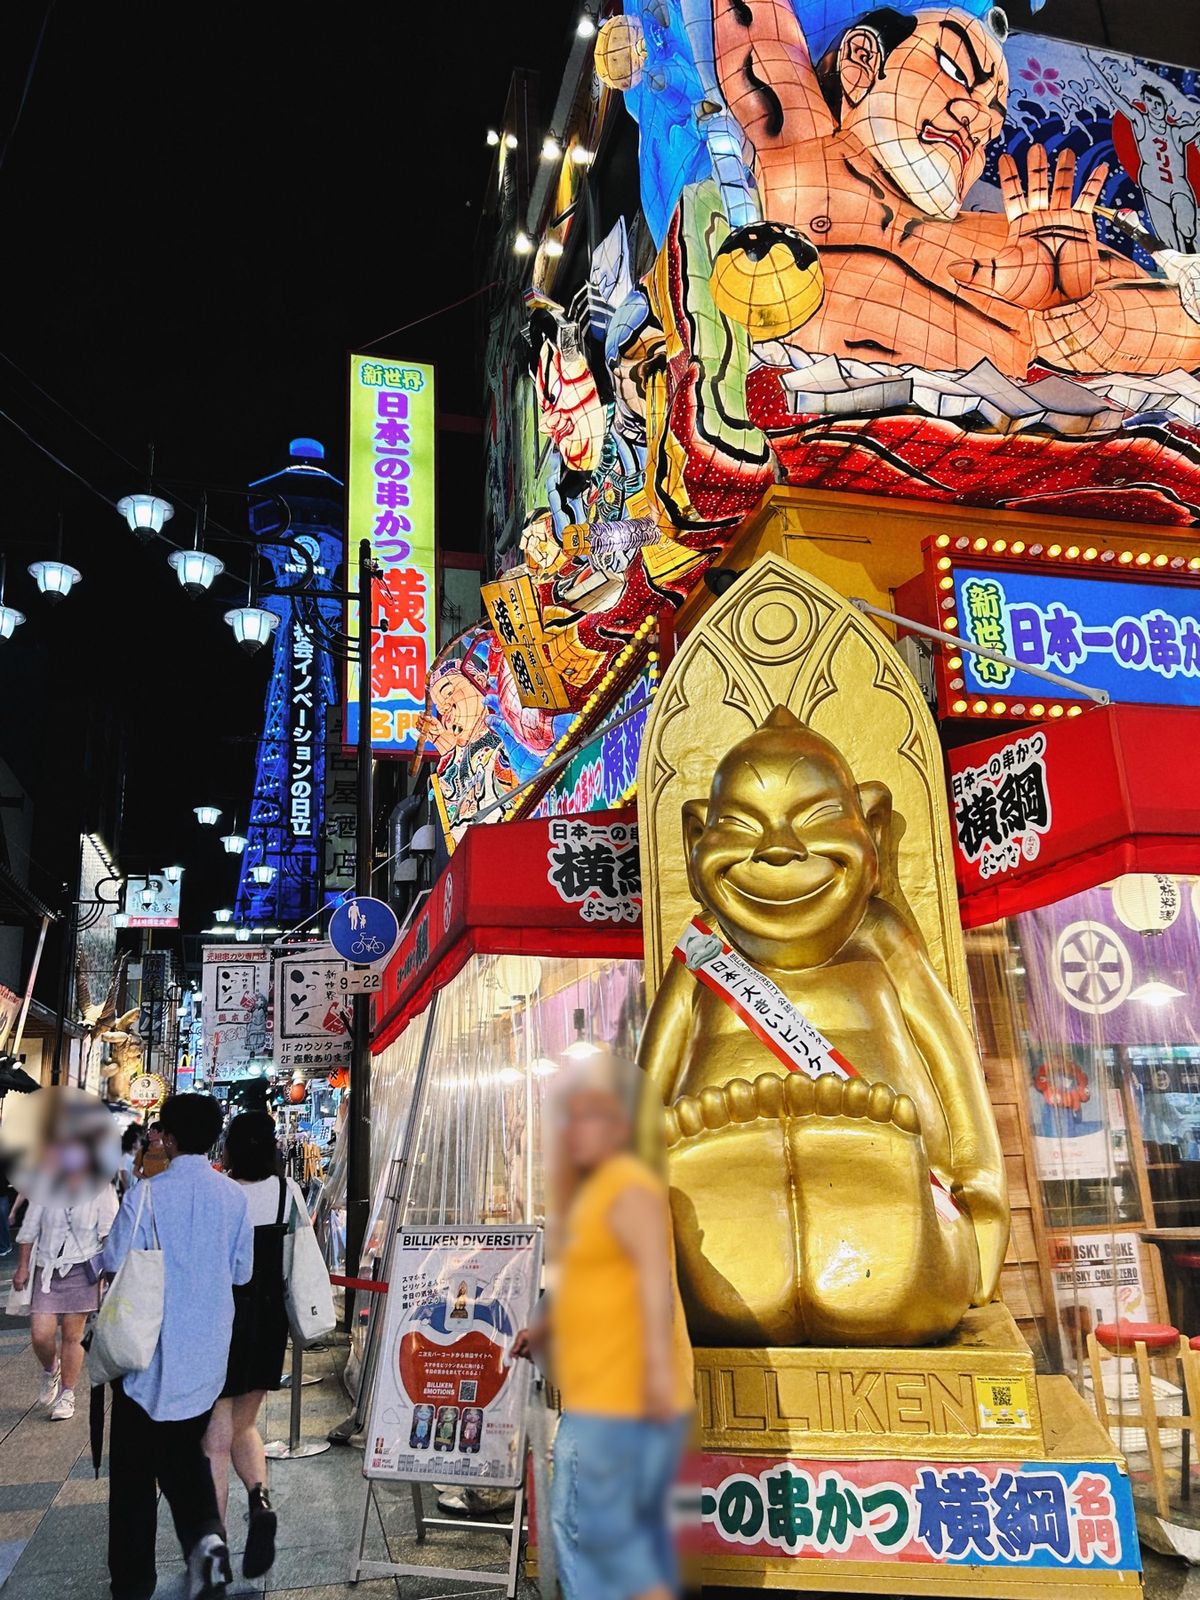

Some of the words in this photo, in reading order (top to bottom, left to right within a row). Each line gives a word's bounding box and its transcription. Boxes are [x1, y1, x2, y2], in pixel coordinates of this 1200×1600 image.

[361, 364, 424, 392] 新世界
[374, 391, 412, 562] 日本一の串かつ
[285, 563, 325, 575] HITAHI
[290, 623, 314, 836] 社会イノベーションの日立
[952, 736, 1043, 797] 日本一の串かつ
[956, 761, 1048, 857] 横綱
[981, 845, 1018, 874] よこづな
[583, 901, 638, 919] よこづな
[324, 969, 338, 1000] 新世界
[340, 974, 380, 990] 9-22
[729, 953, 752, 973] BILLIKEN
[751, 970, 780, 996] DIVERSITY
[710, 960, 836, 1076] 日本一大きいビリケ
[281, 1056, 291, 1064] 2F
[282, 1044, 291, 1052] 1F
[403, 1235, 459, 1247] BILLIKEN
[462, 1235, 534, 1247] DIVERSITY
[1055, 1244, 1100, 1260] WHISKY
[1094, 1269, 1116, 1280] COK
[1120, 1267, 1138, 1279] ZERO
[698, 1368, 979, 1437] ILLIKEN
[915, 1470, 1071, 1558] 横綱
[1072, 1476, 1115, 1559] 名門
